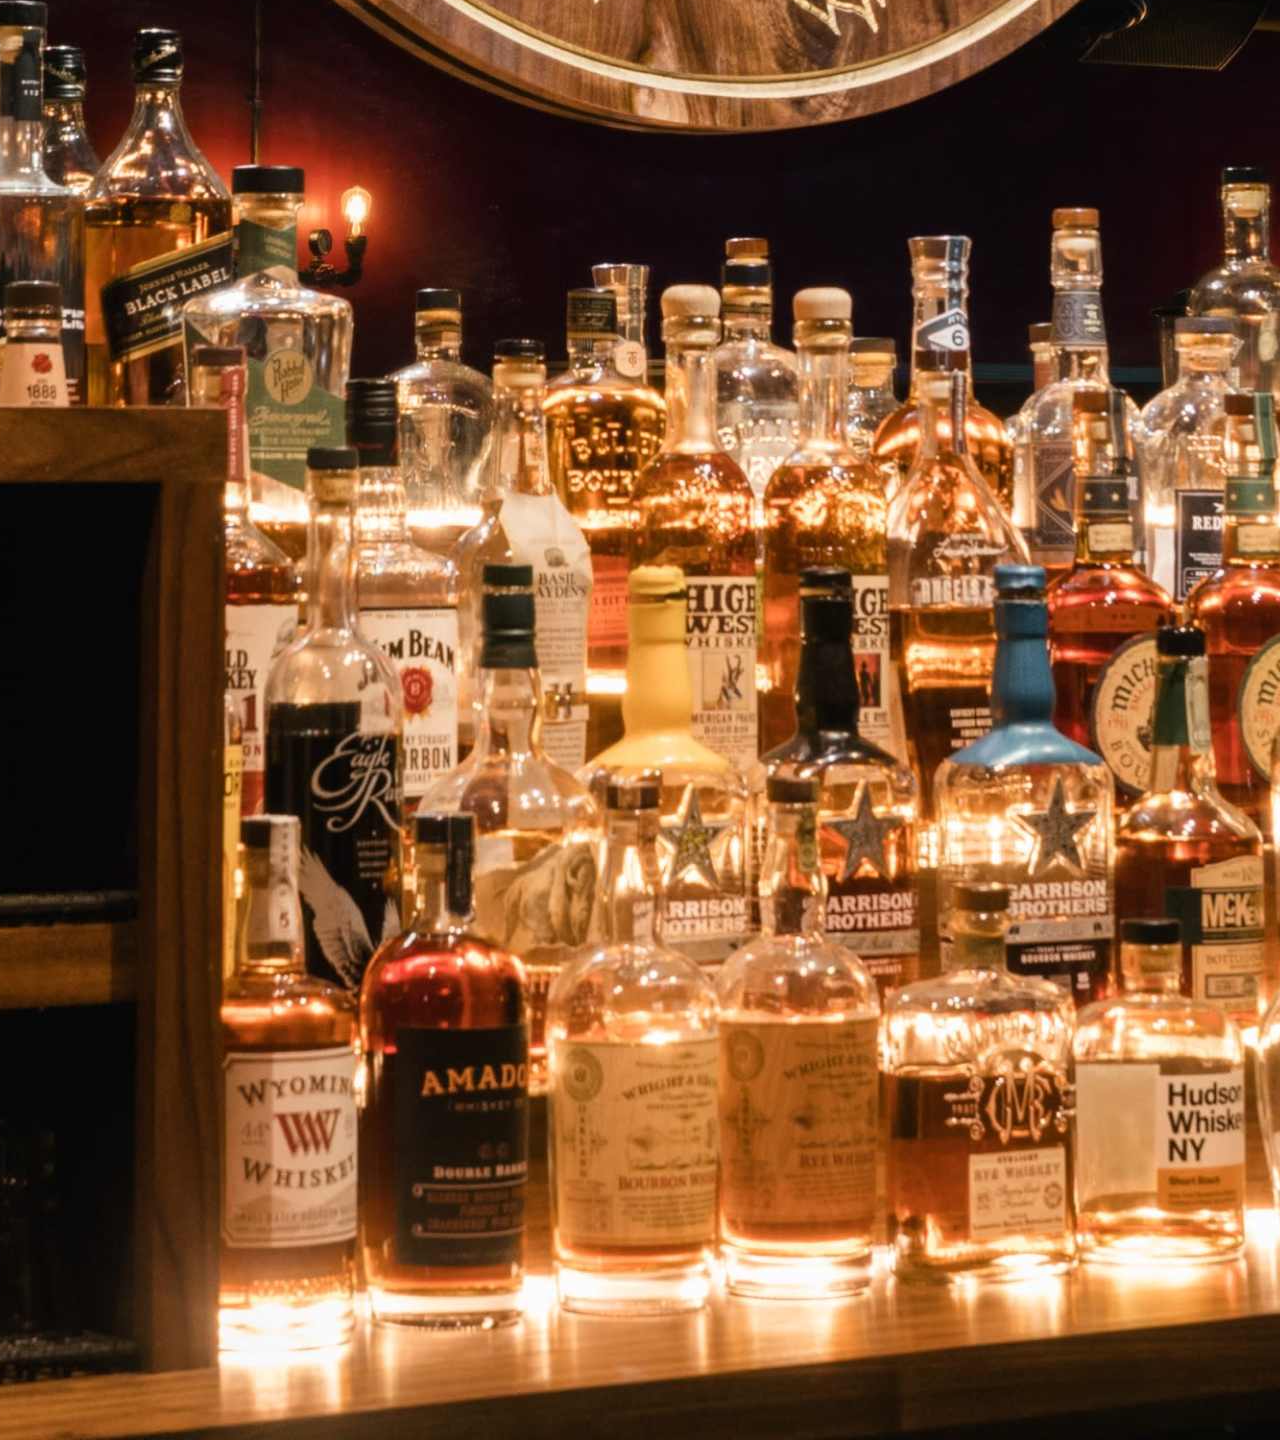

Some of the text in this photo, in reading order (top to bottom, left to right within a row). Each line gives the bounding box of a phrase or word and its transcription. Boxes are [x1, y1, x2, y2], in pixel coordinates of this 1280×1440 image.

[125, 266, 231, 316] BLACK LABEL
[952, 329, 965, 346] 6
[26, 385, 57, 399] 1888
[538, 572, 576, 586] BASIL
[536, 584, 587, 599] AYDEN'S
[311, 732, 391, 798] Eagle
[1008, 880, 1108, 900] GARRISON
[664, 897, 747, 918] RRISON
[826, 891, 913, 912] ARRISON
[1007, 898, 1109, 918] BROTHERS
[826, 909, 914, 931] ROTHERS
[1020, 950, 1097, 964] BOURBON WHISKEY
[783, 1055, 843, 1081] WRIGHT
[622, 1074, 683, 1101] WRIGHT
[1168, 1137, 1206, 1162] NY
[800, 1153, 829, 1169] RYE
[433, 1165, 492, 1179] DOUBLE
[1004, 1162, 1061, 1181] WHISKEY
[618, 1173, 689, 1192] BOURBON
